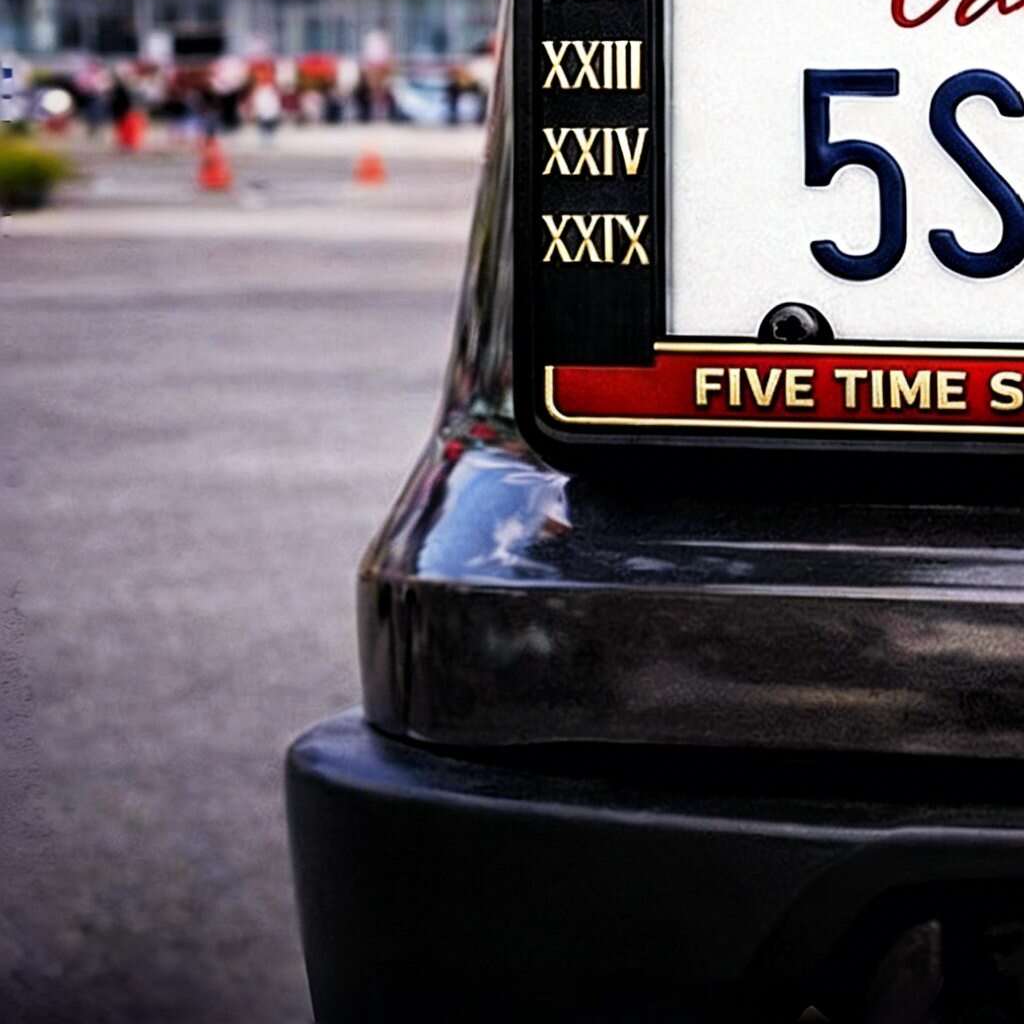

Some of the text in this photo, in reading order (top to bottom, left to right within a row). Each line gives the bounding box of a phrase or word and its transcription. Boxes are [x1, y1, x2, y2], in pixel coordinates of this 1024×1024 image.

[541, 40, 644, 91] XXIII
[541, 126, 650, 177] XXIV
[541, 213, 651, 266] XXIX
[695, 367, 815, 408] FIVE
[834, 369, 968, 410] TIME
